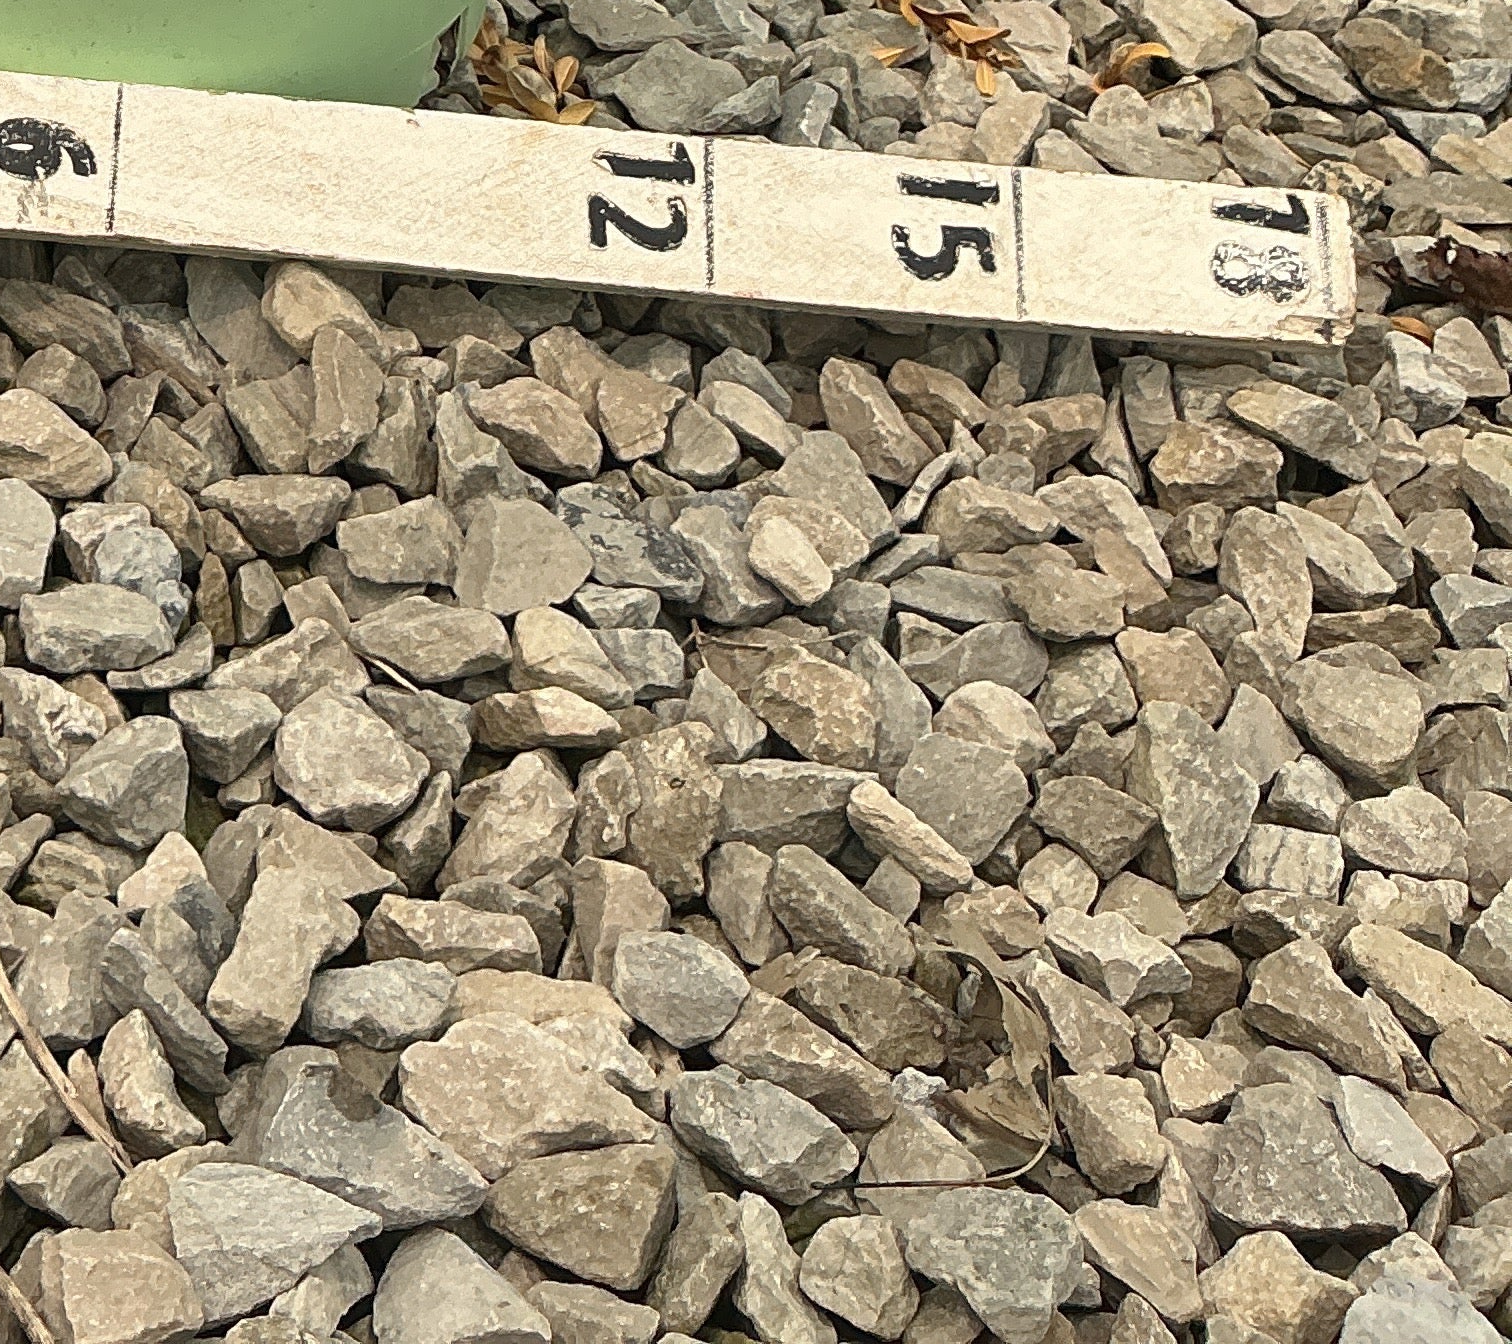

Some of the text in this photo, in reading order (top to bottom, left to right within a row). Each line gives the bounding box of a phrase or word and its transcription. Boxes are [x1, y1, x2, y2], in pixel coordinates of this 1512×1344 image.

[587, 141, 696, 252] 12
[891, 173, 1000, 281] 15
[1210, 194, 1312, 305] 18
